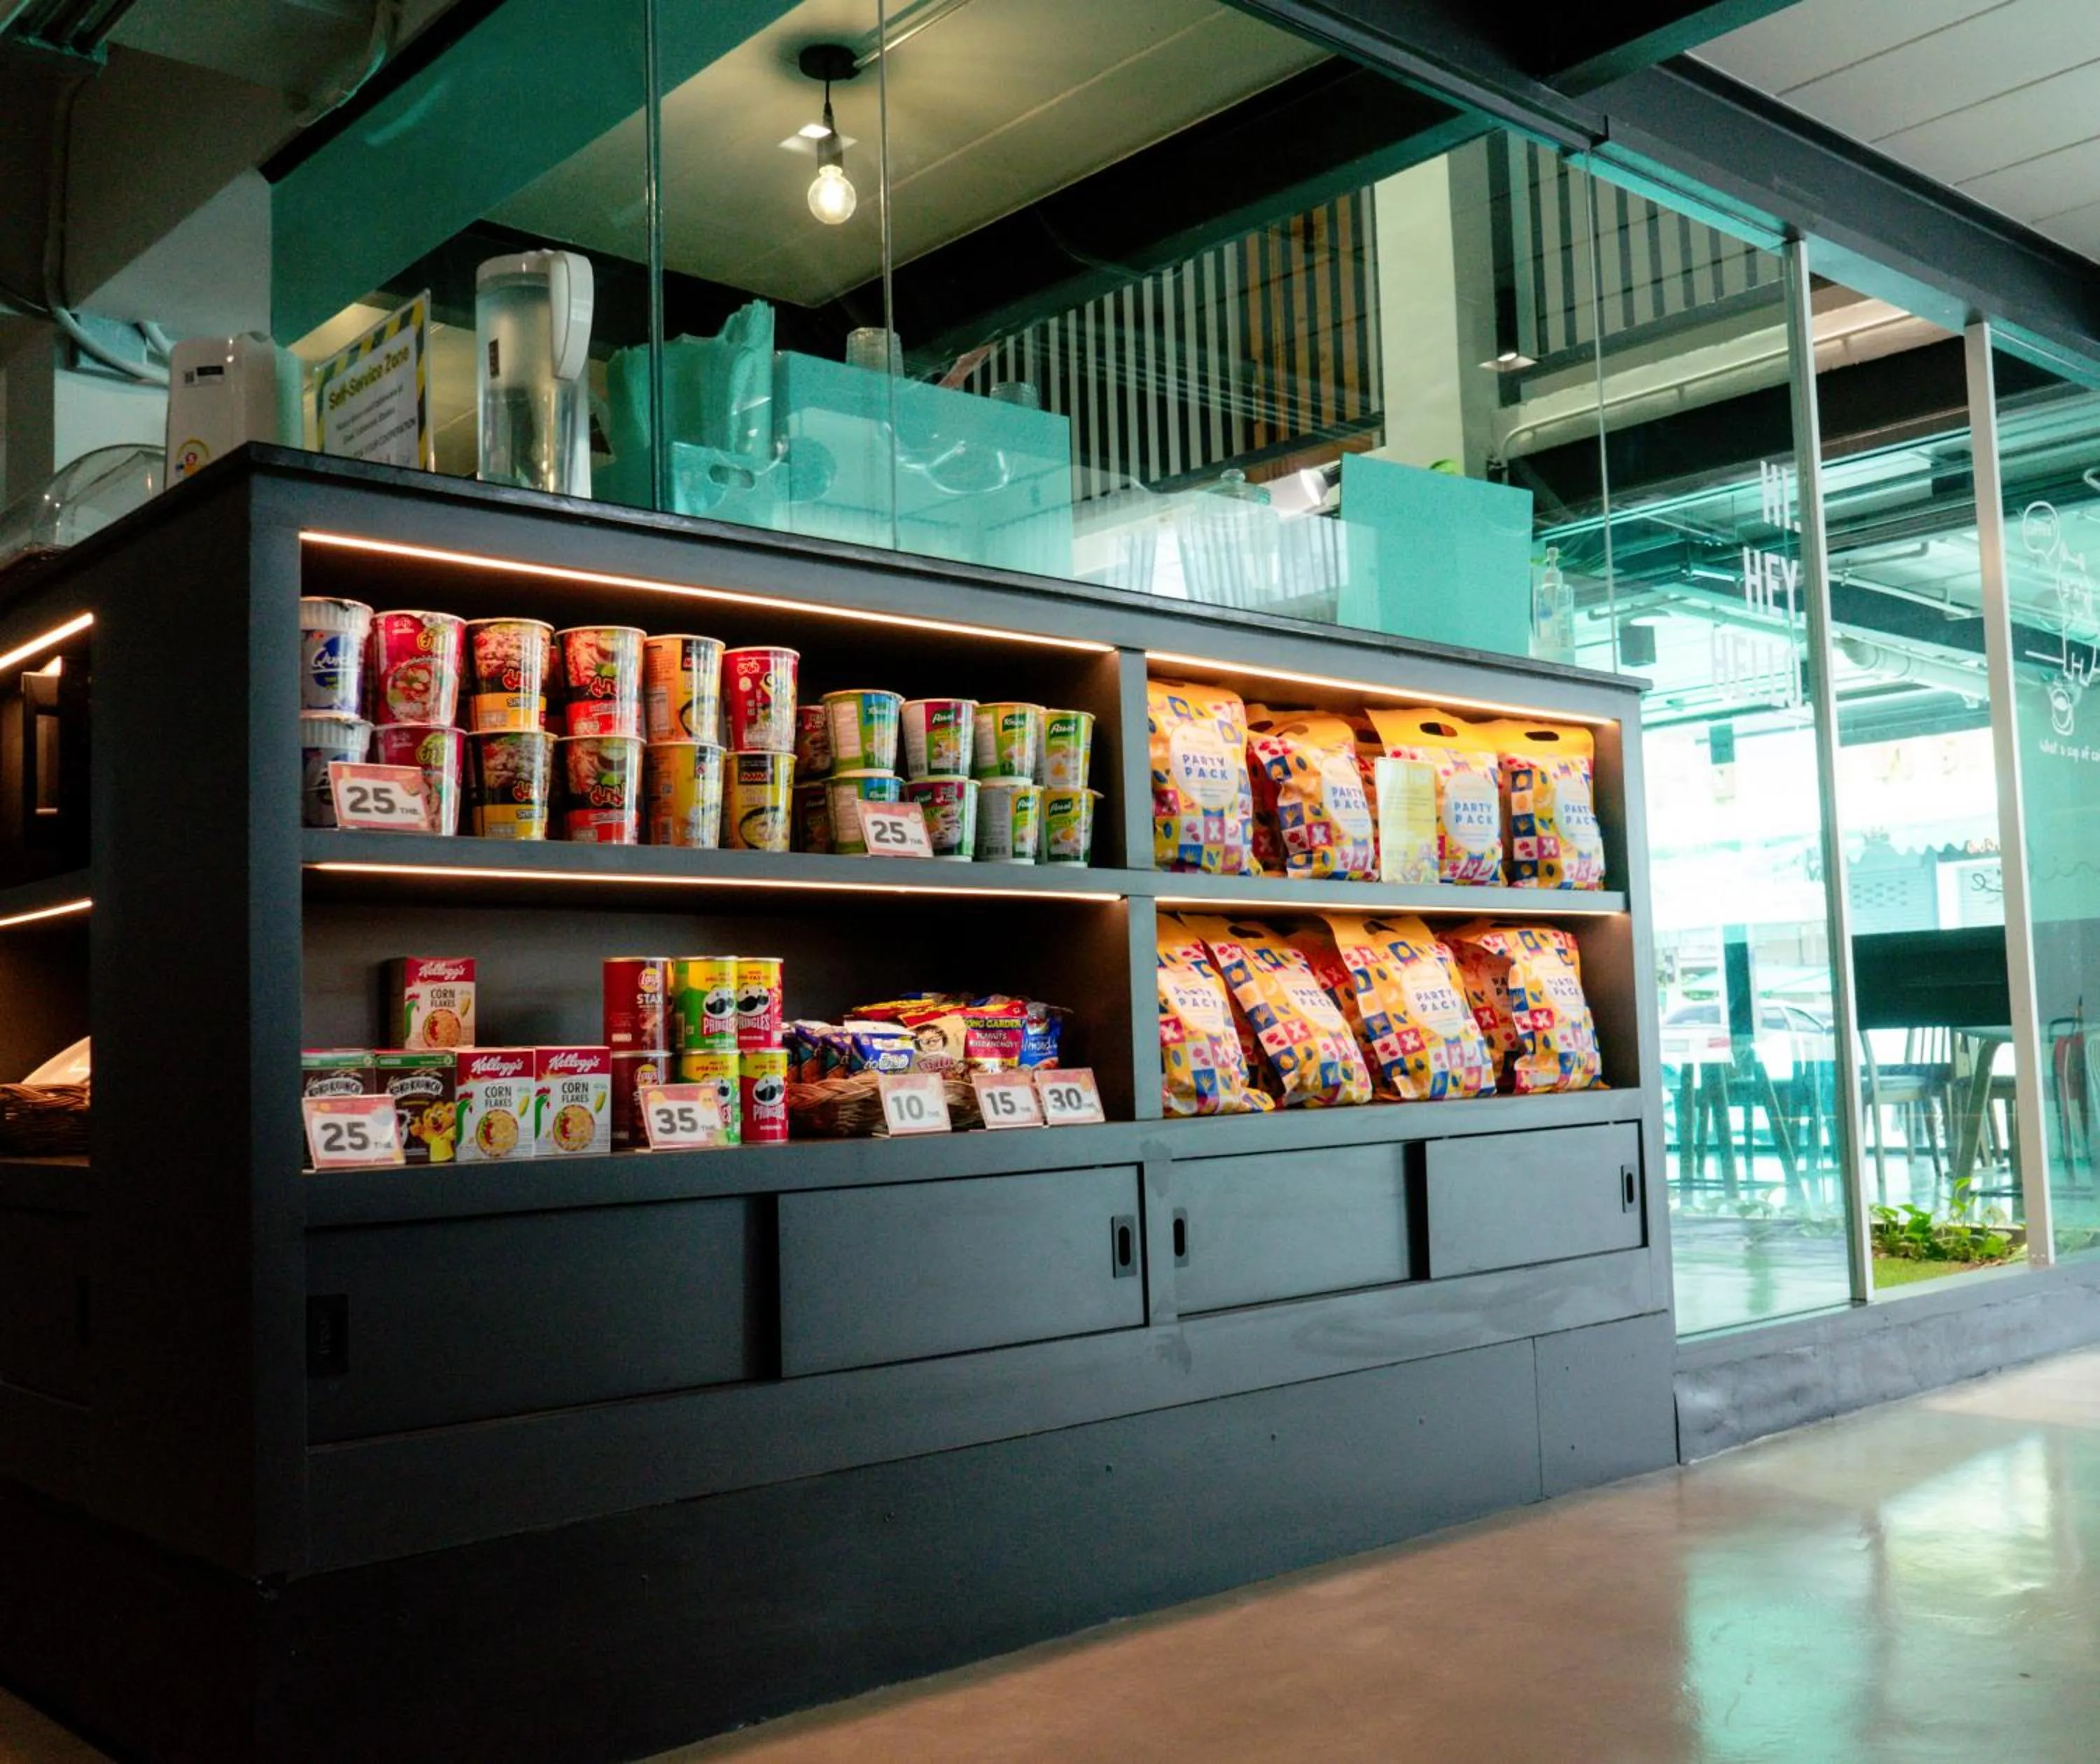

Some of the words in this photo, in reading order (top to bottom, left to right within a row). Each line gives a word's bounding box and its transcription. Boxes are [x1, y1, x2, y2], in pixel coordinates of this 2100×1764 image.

[384, 346, 410, 374] Zone
[1182, 754, 1224, 766] PARTY
[1184, 766, 1228, 780] PACK
[346, 785, 397, 815] 25
[1453, 802, 1492, 813] PARTY
[1455, 813, 1494, 825] PACK
[871, 820, 907, 844] 25
[418, 960, 466, 981] Kellogg's
[430, 988, 456, 999] CORN
[430, 999, 456, 1008] FLAKES
[470, 1056, 524, 1076] Kellogg's
[548, 1052, 601, 1072] Kellogg's
[484, 1086, 512, 1098] CORN
[561, 1082, 589, 1093] CORN
[484, 1098, 512, 1108] FLAKES
[561, 1093, 589, 1104] FLAKES
[891, 1095, 925, 1121] 10
[986, 1091, 1016, 1116] 15
[1048, 1087, 1083, 1112] 30
[654, 1107, 698, 1135] 35
[321, 1121, 370, 1152] 25
